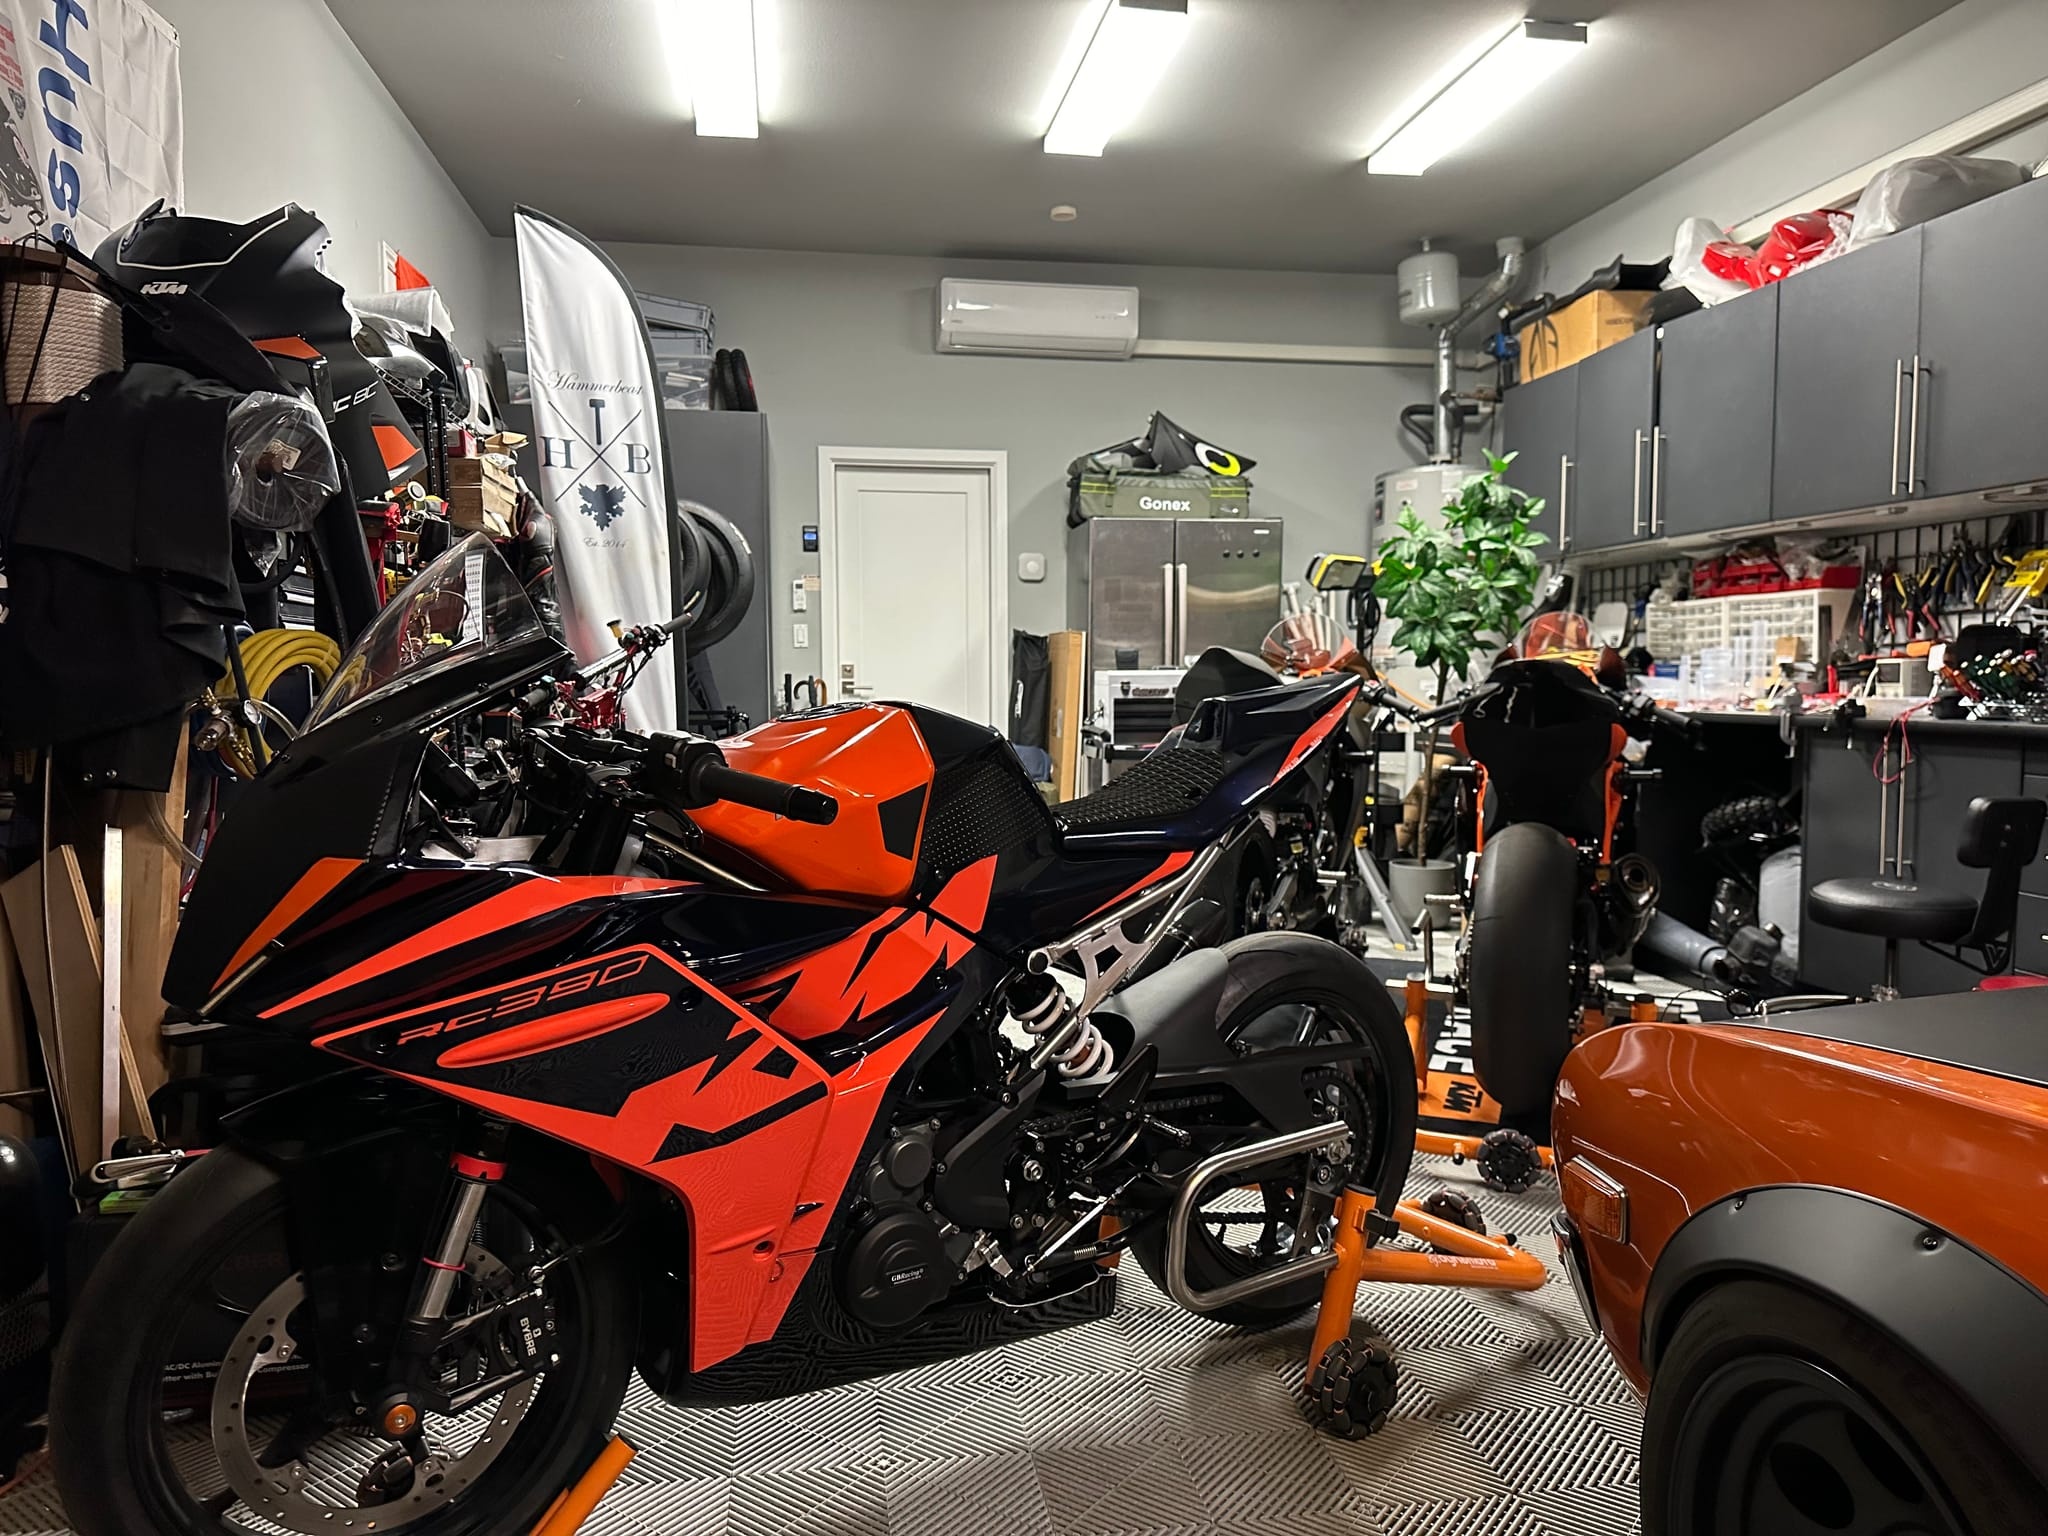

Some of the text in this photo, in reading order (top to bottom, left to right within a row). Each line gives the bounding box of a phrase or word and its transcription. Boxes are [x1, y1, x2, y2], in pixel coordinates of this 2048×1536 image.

[140, 281, 188, 295] KTM
[539, 435, 652, 475] H B
[1139, 496, 1191, 512] Gonex
[398, 955, 650, 1045] RC390
[1442, 1080, 1484, 1113] KTM
[520, 1317, 537, 1357] BYBRE
[183, 1373, 203, 1381] with
[256, 1363, 311, 1374] Compressor
